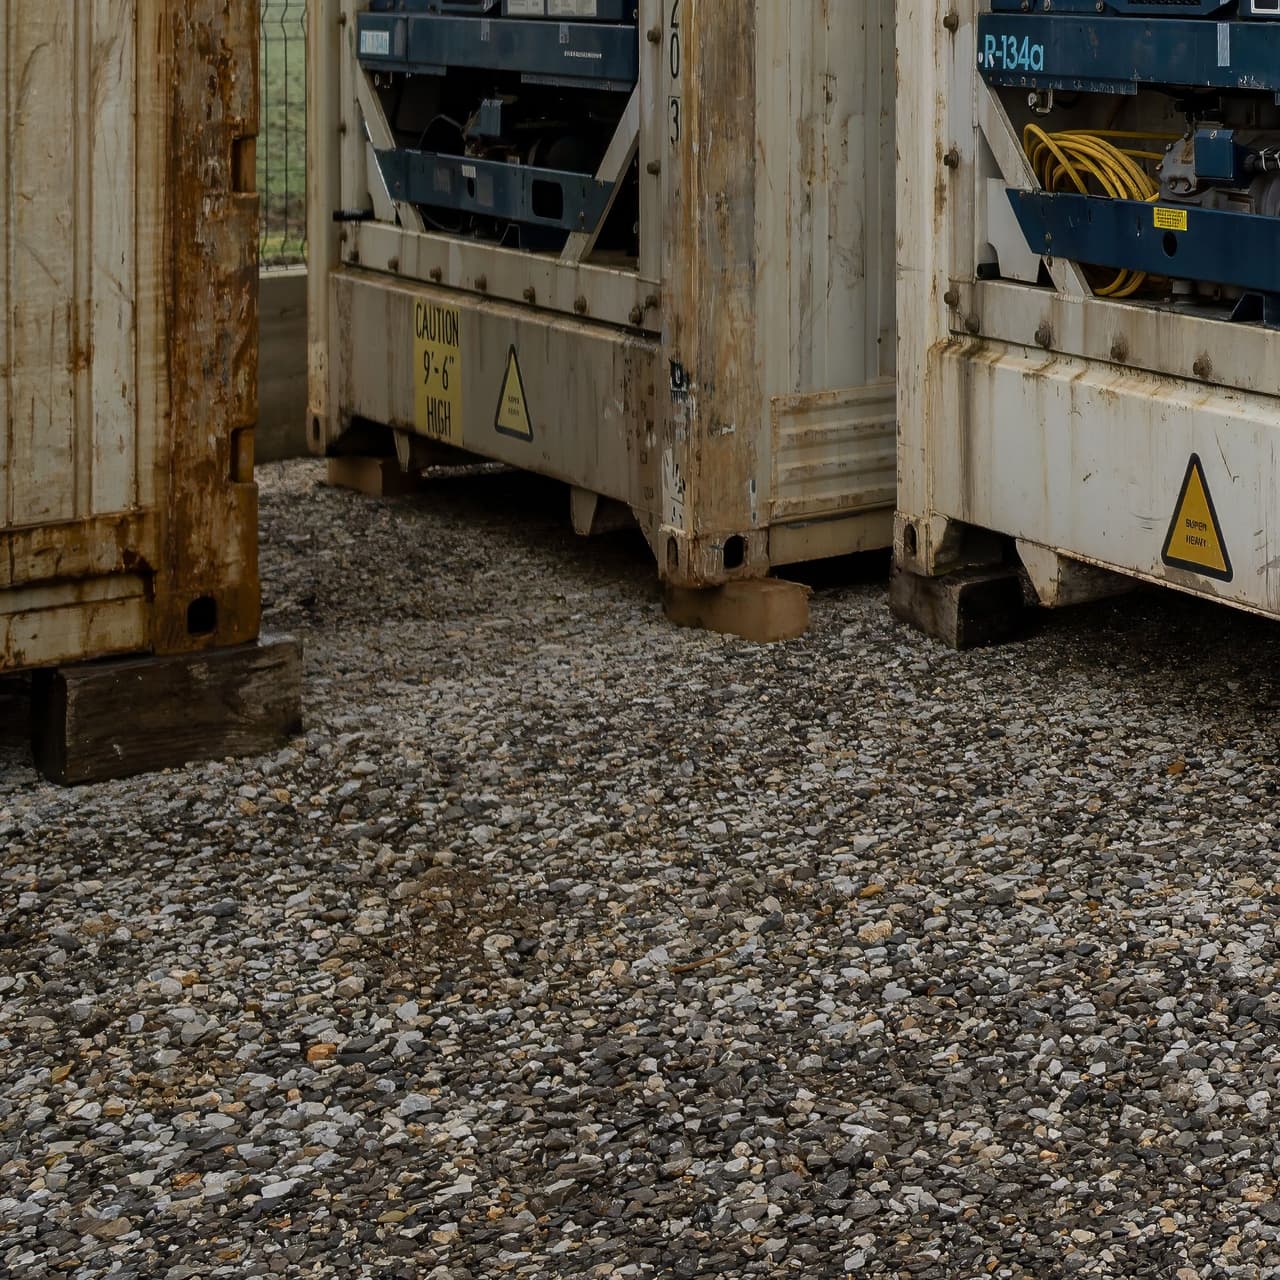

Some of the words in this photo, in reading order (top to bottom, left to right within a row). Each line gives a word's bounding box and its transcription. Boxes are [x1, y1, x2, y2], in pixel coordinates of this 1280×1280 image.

[984, 34, 1044, 71] R-134a
[416, 302, 459, 347] CAUTION
[427, 395, 451, 438] HIGH
[1185, 518, 1207, 531] SUPER
